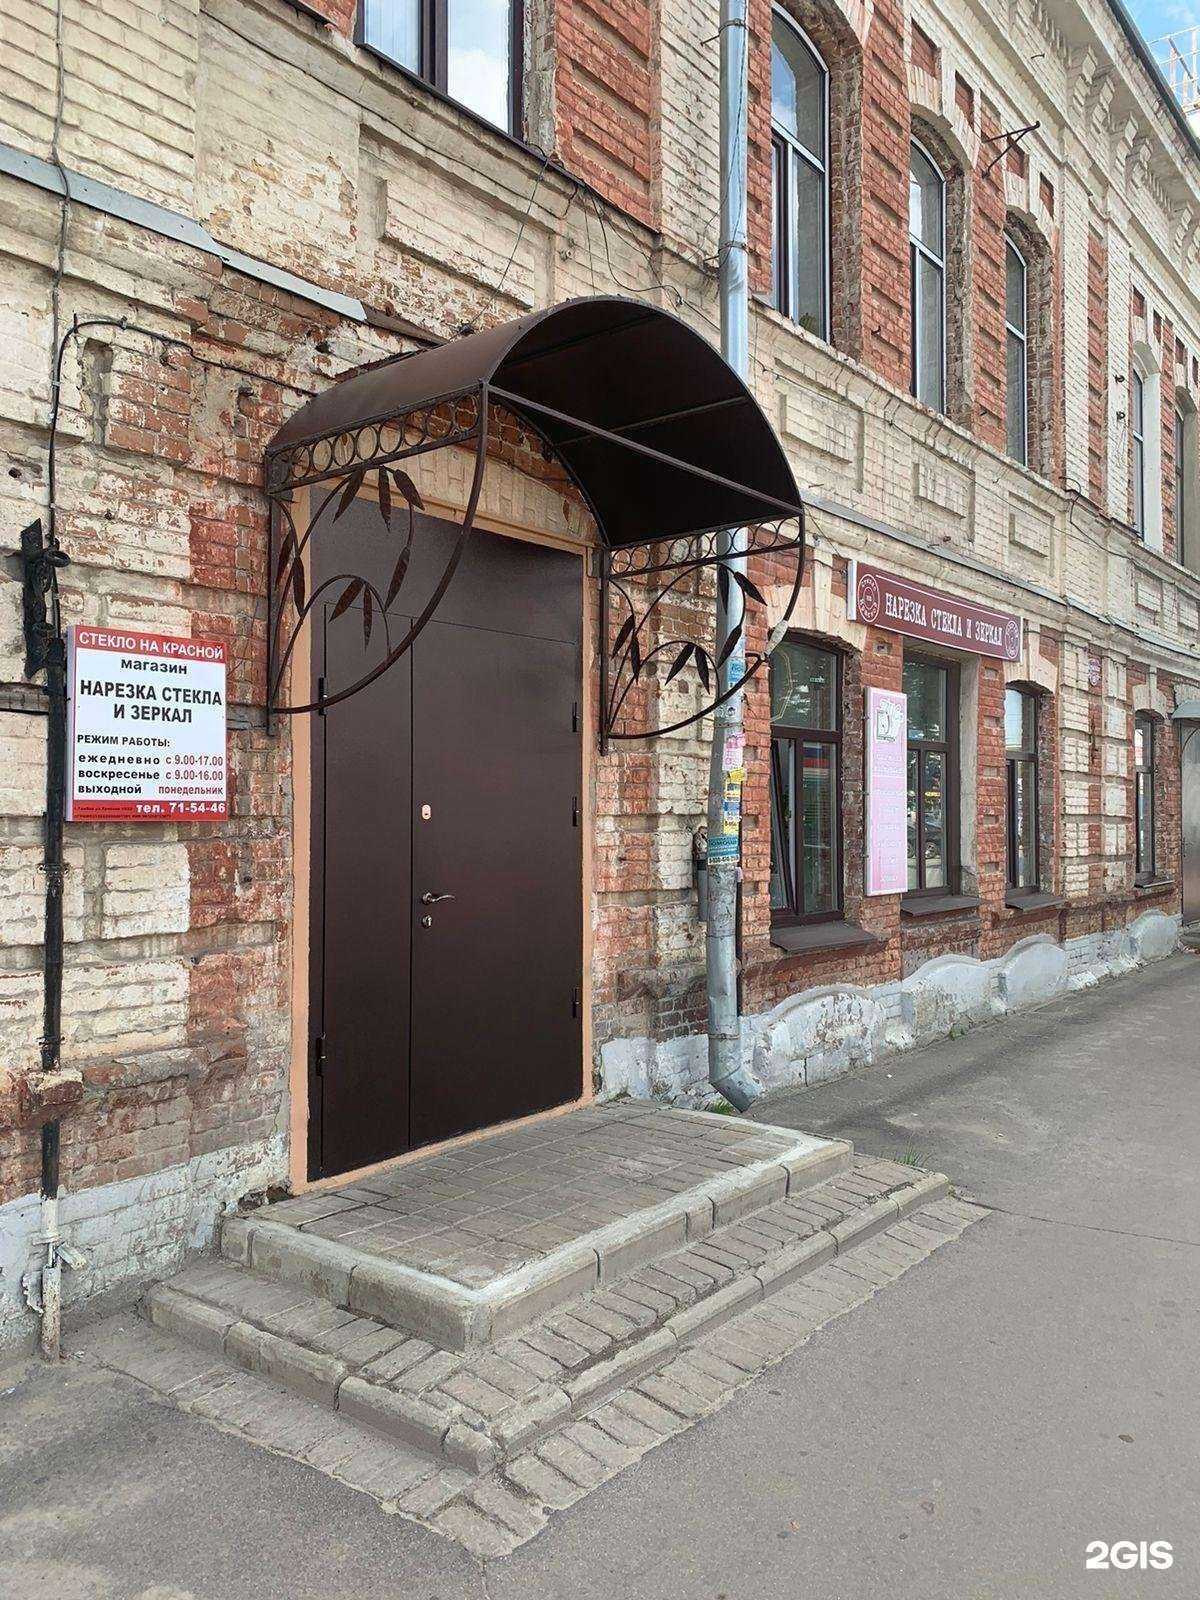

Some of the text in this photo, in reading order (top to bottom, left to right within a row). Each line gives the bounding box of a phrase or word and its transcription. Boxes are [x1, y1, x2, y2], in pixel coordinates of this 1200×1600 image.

[885, 592, 927, 627] НАРЕЗКА
[931, 608, 963, 637] СТЕКЛА
[966, 618, 972, 639] И
[975, 620, 1003, 646] ЗЕРКАЛ
[79, 631, 223, 660] СТЕКЛО НА КРАСНОЙ
[121, 659, 188, 675] магазин
[80, 680, 222, 706] НАРЕЗКА СТЕКЛА
[114, 704, 192, 723] И ЗЕРКАЛ
[77, 734, 170, 747] РЕЖИМ РАБОТЫ:
[78, 755, 160, 765] ежедневно
[174, 755, 223, 766] 9.00-17.00
[78, 770, 160, 780] воскресенье
[174, 769, 223, 780] 9.00-16.00
[78, 783, 223, 795] выходной понедельник
[136, 804, 165, 814] тел.
[169, 802, 226, 814] 71-54-46
